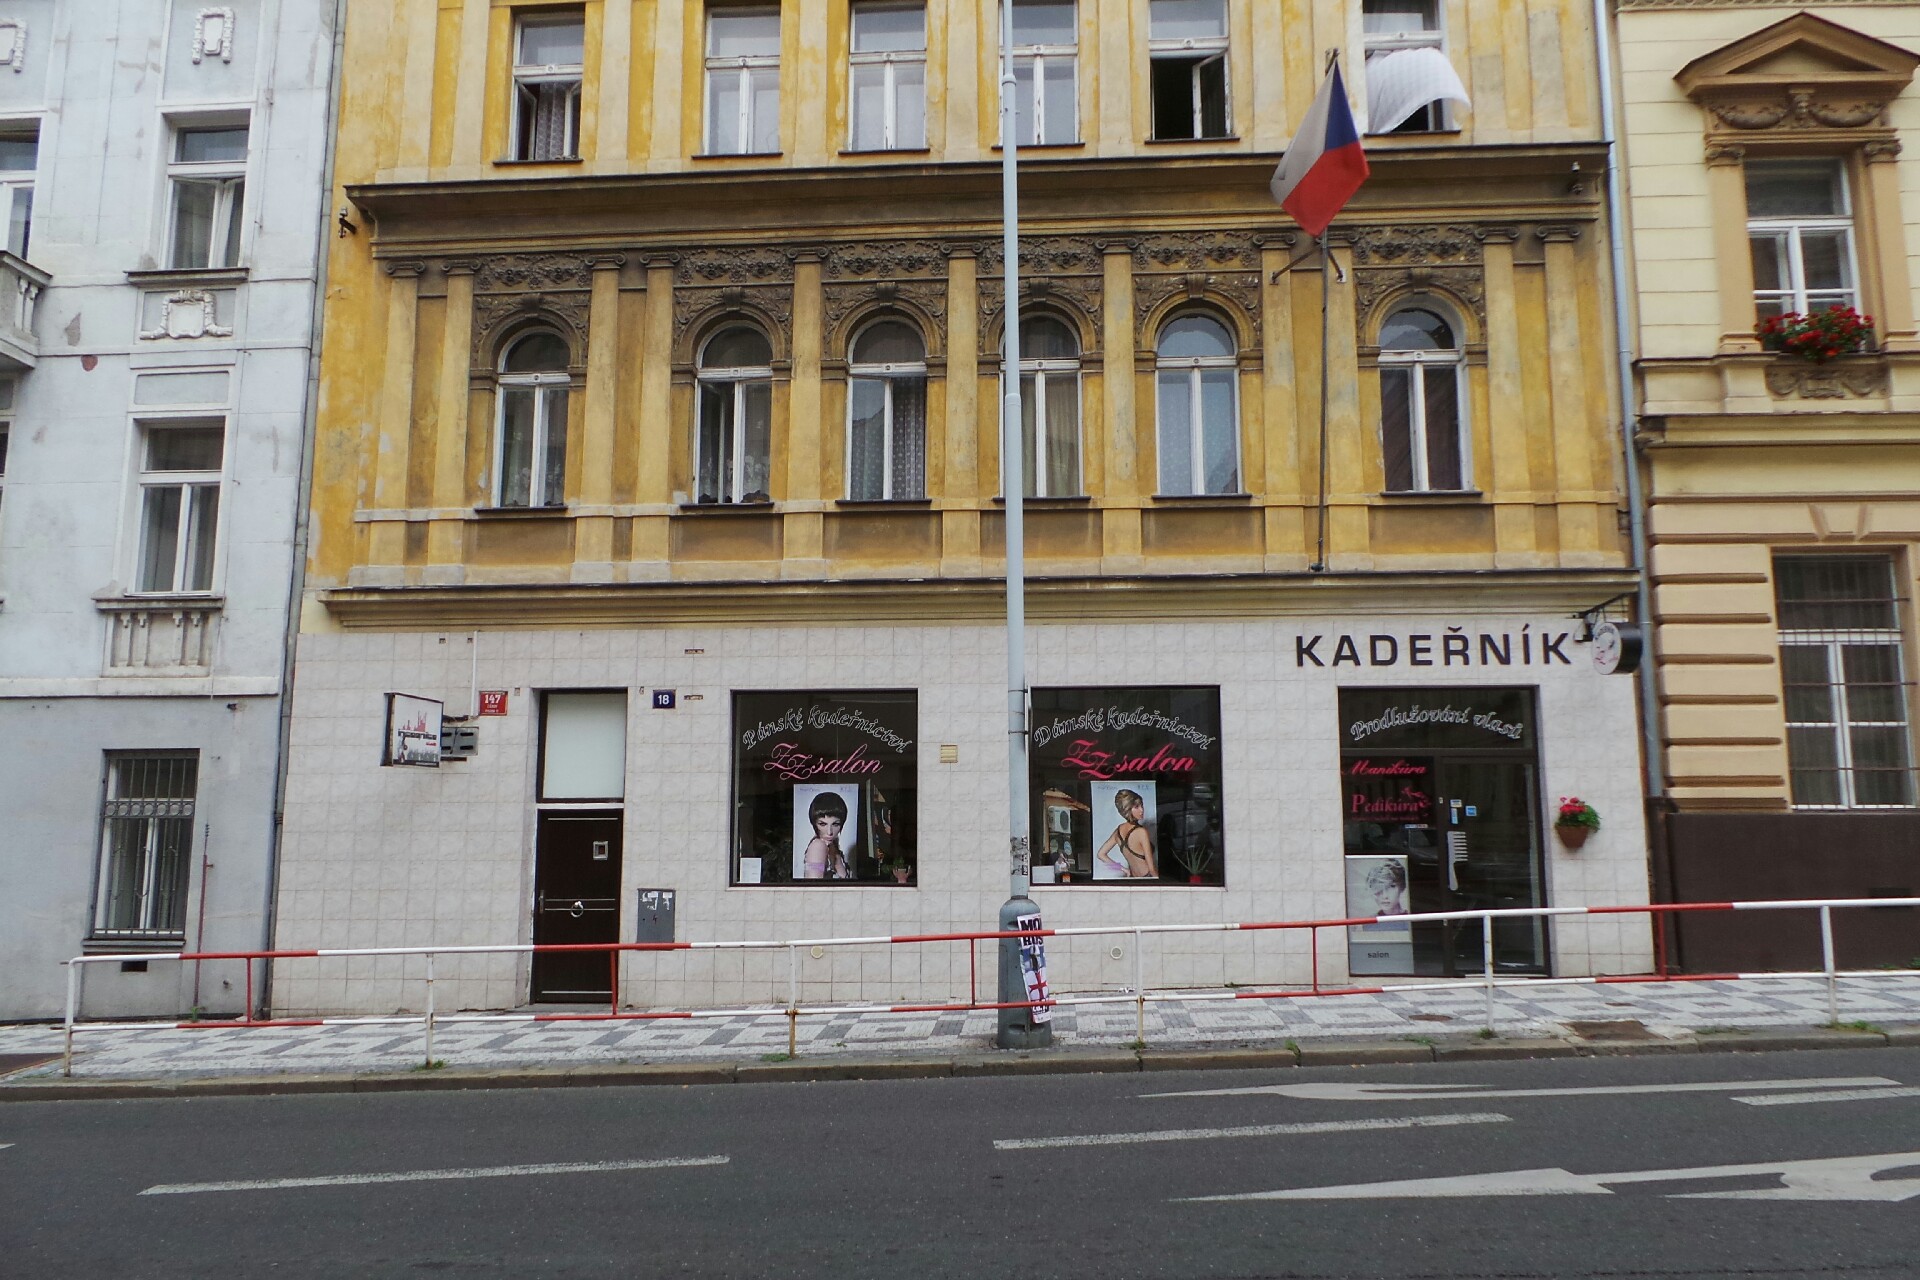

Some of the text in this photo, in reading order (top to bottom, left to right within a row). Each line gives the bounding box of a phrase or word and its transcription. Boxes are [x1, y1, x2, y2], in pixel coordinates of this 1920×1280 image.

[1295, 623, 1572, 667] KADEŘNÍK
[485, 694, 501, 704] 147
[658, 694, 670, 705] 18
[742, 705, 912, 753] Pánské kadeřnictví
[1033, 705, 1216, 750] Dámské kadeřnictví
[1350, 705, 1524, 741] Prodlužování vlasů
[1349, 760, 1427, 776] Manikúra
[1351, 794, 1419, 813] Pedikúra
[1367, 950, 1390, 959] salon
